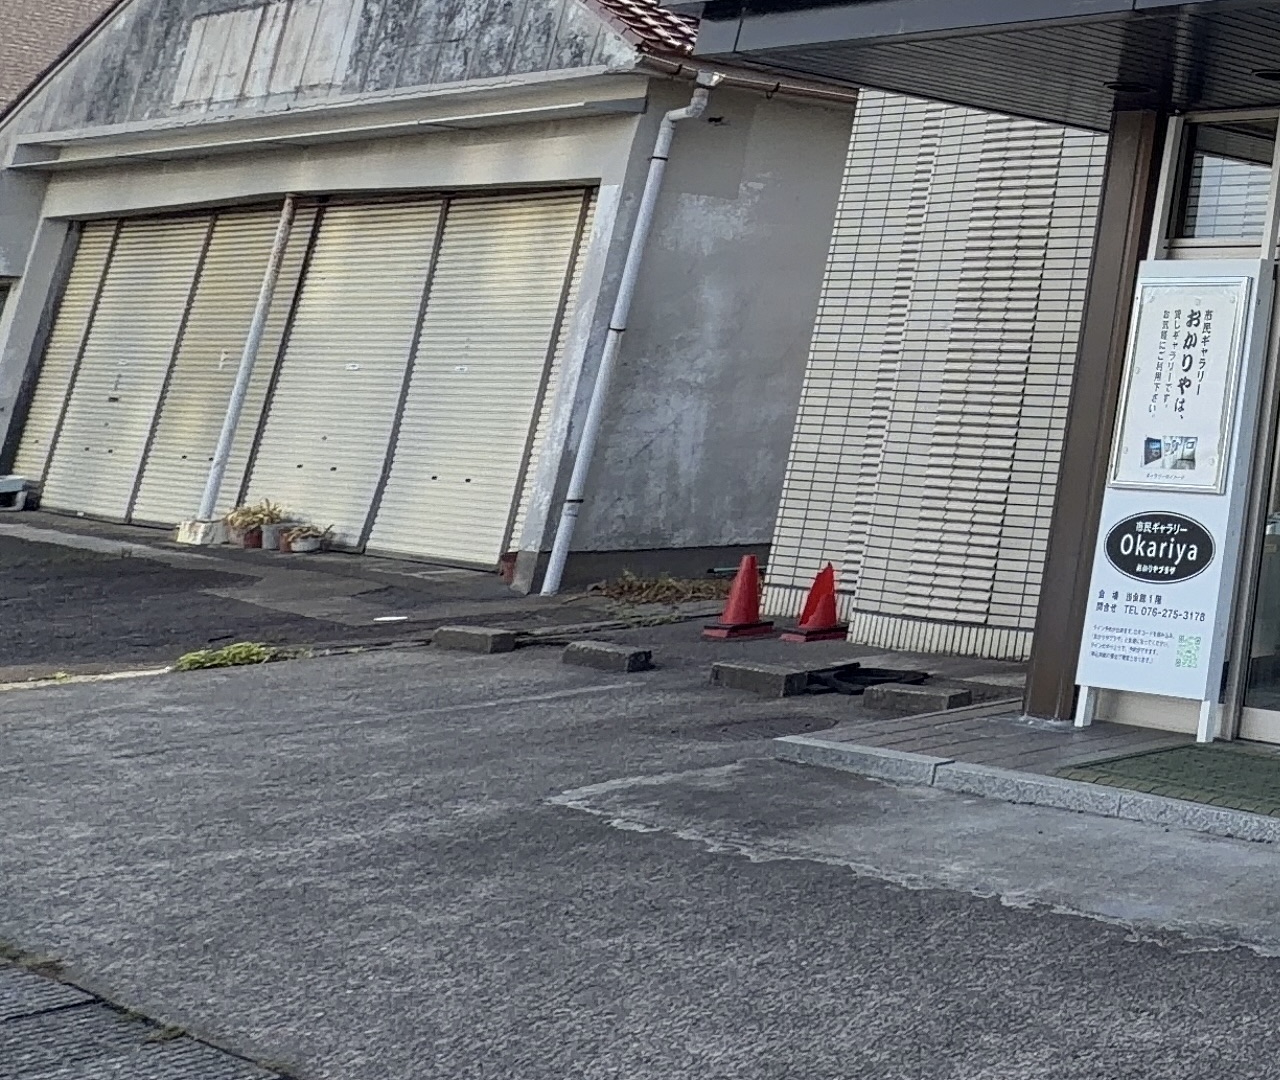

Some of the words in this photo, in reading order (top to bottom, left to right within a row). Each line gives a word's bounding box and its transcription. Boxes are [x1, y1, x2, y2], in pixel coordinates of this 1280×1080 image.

[1196, 309, 1213, 396] 市民ギャラリー
[1135, 521, 1188, 535] 市民ギャラリー
[1120, 533, 1199, 565] Okariya
[1124, 604, 1139, 616] TEL
[1141, 606, 1206, 622] 076-275-3178
